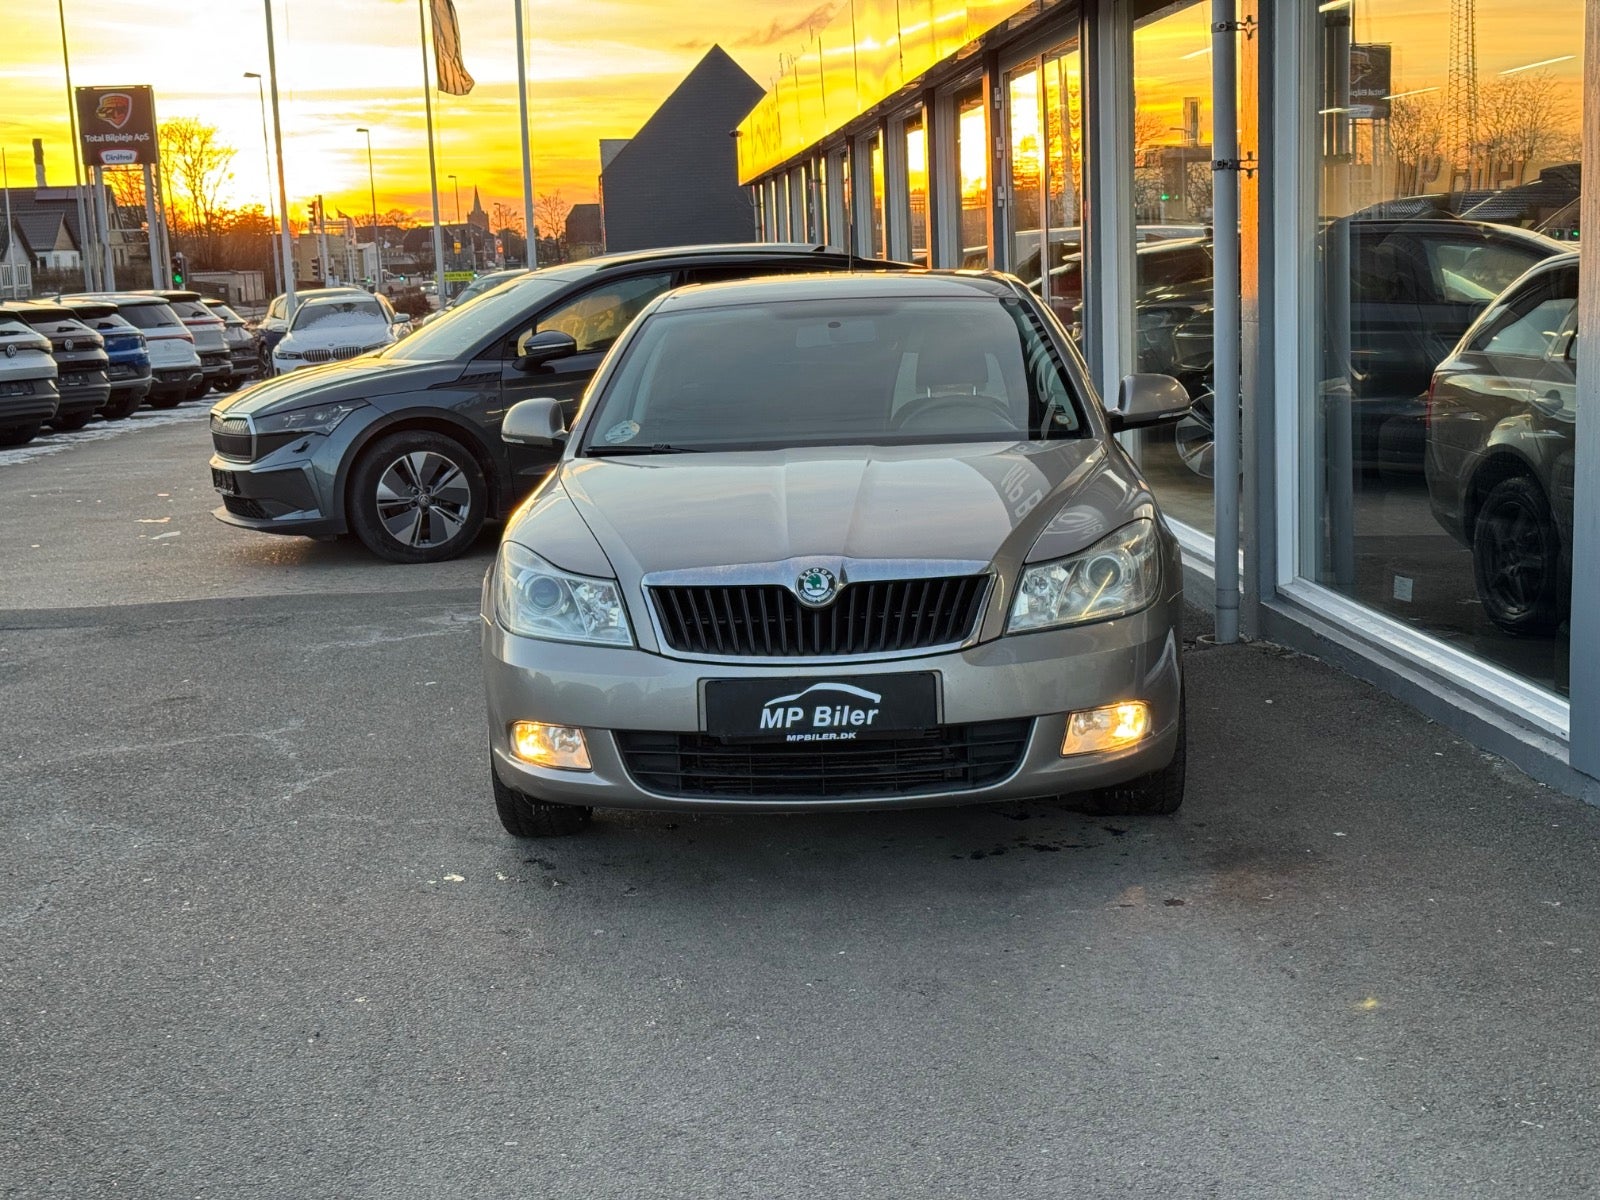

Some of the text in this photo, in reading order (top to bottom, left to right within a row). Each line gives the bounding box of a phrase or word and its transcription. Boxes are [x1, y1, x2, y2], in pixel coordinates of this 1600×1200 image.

[84, 133, 150, 143] Total Bilpleje ApS
[759, 705, 879, 729] MP Biler
[786, 731, 857, 742] MPBILER.DK
